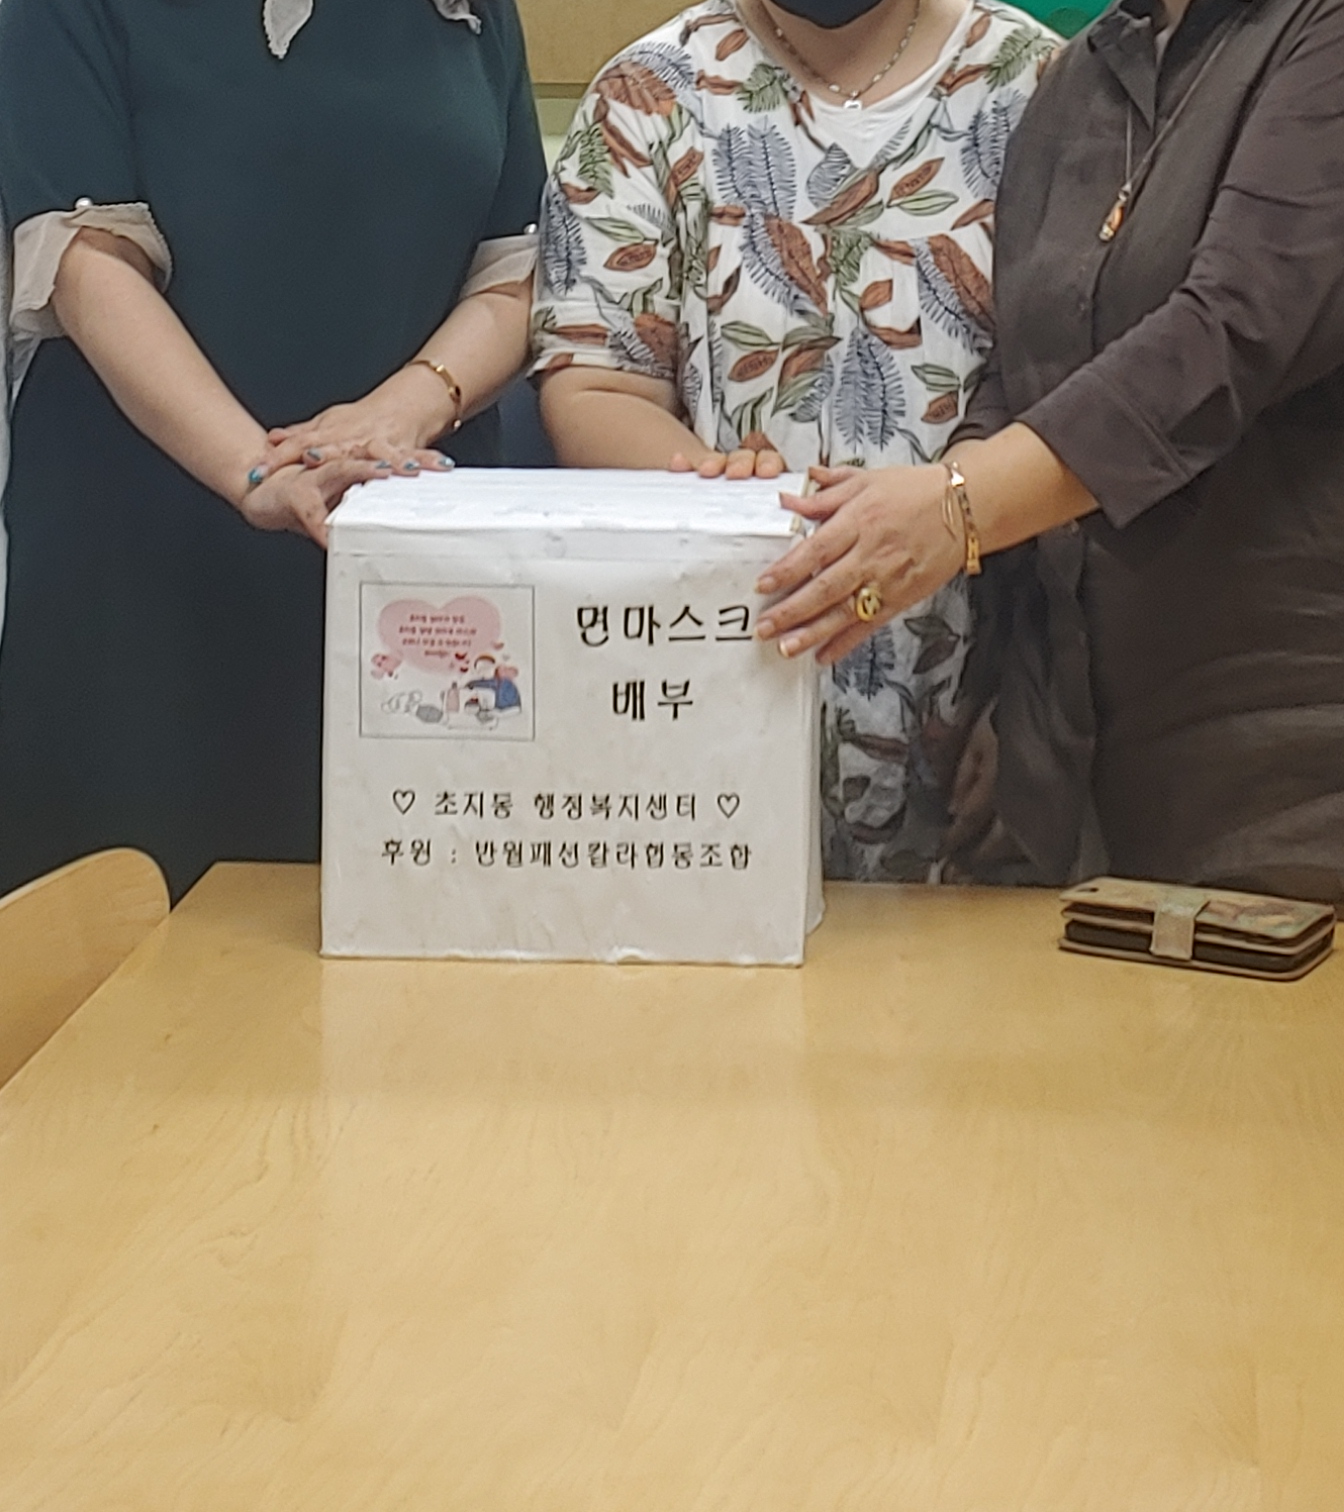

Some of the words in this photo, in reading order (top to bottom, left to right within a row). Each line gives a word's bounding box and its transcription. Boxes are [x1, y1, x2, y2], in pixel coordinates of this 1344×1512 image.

[576, 604, 753, 648] 면마스크
[612, 679, 694, 721] 배부
[434, 790, 513, 820] 초지동
[533, 791, 696, 821] 행정복지센터
[381, 838, 432, 867] 후원
